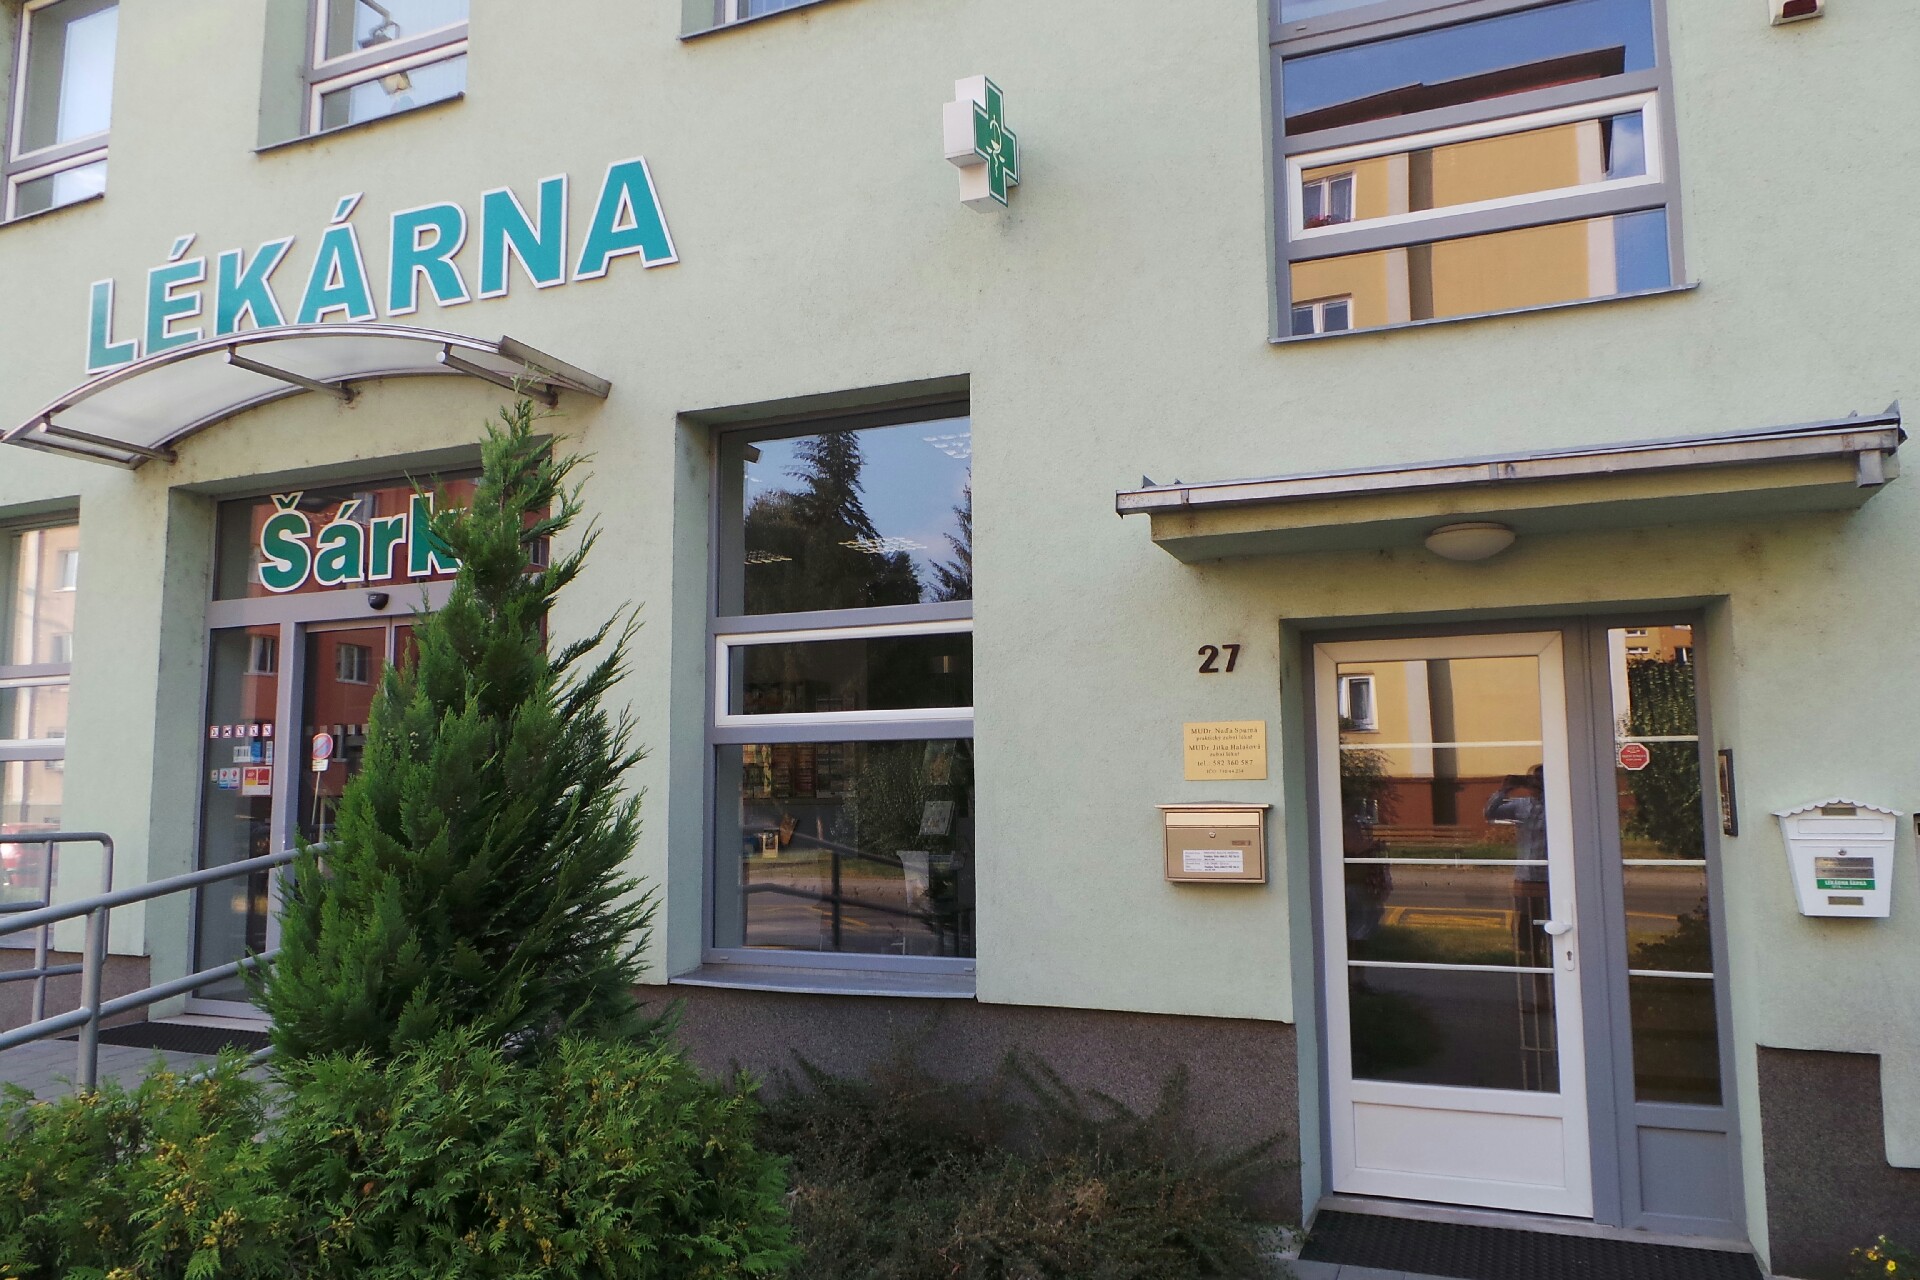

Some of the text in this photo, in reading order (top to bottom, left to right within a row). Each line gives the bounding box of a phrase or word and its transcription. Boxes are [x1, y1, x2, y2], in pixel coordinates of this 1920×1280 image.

[85, 155, 679, 375] LÉKÁRNA
[258, 491, 519, 593] Šárk
[1198, 644, 1240, 673] 27
